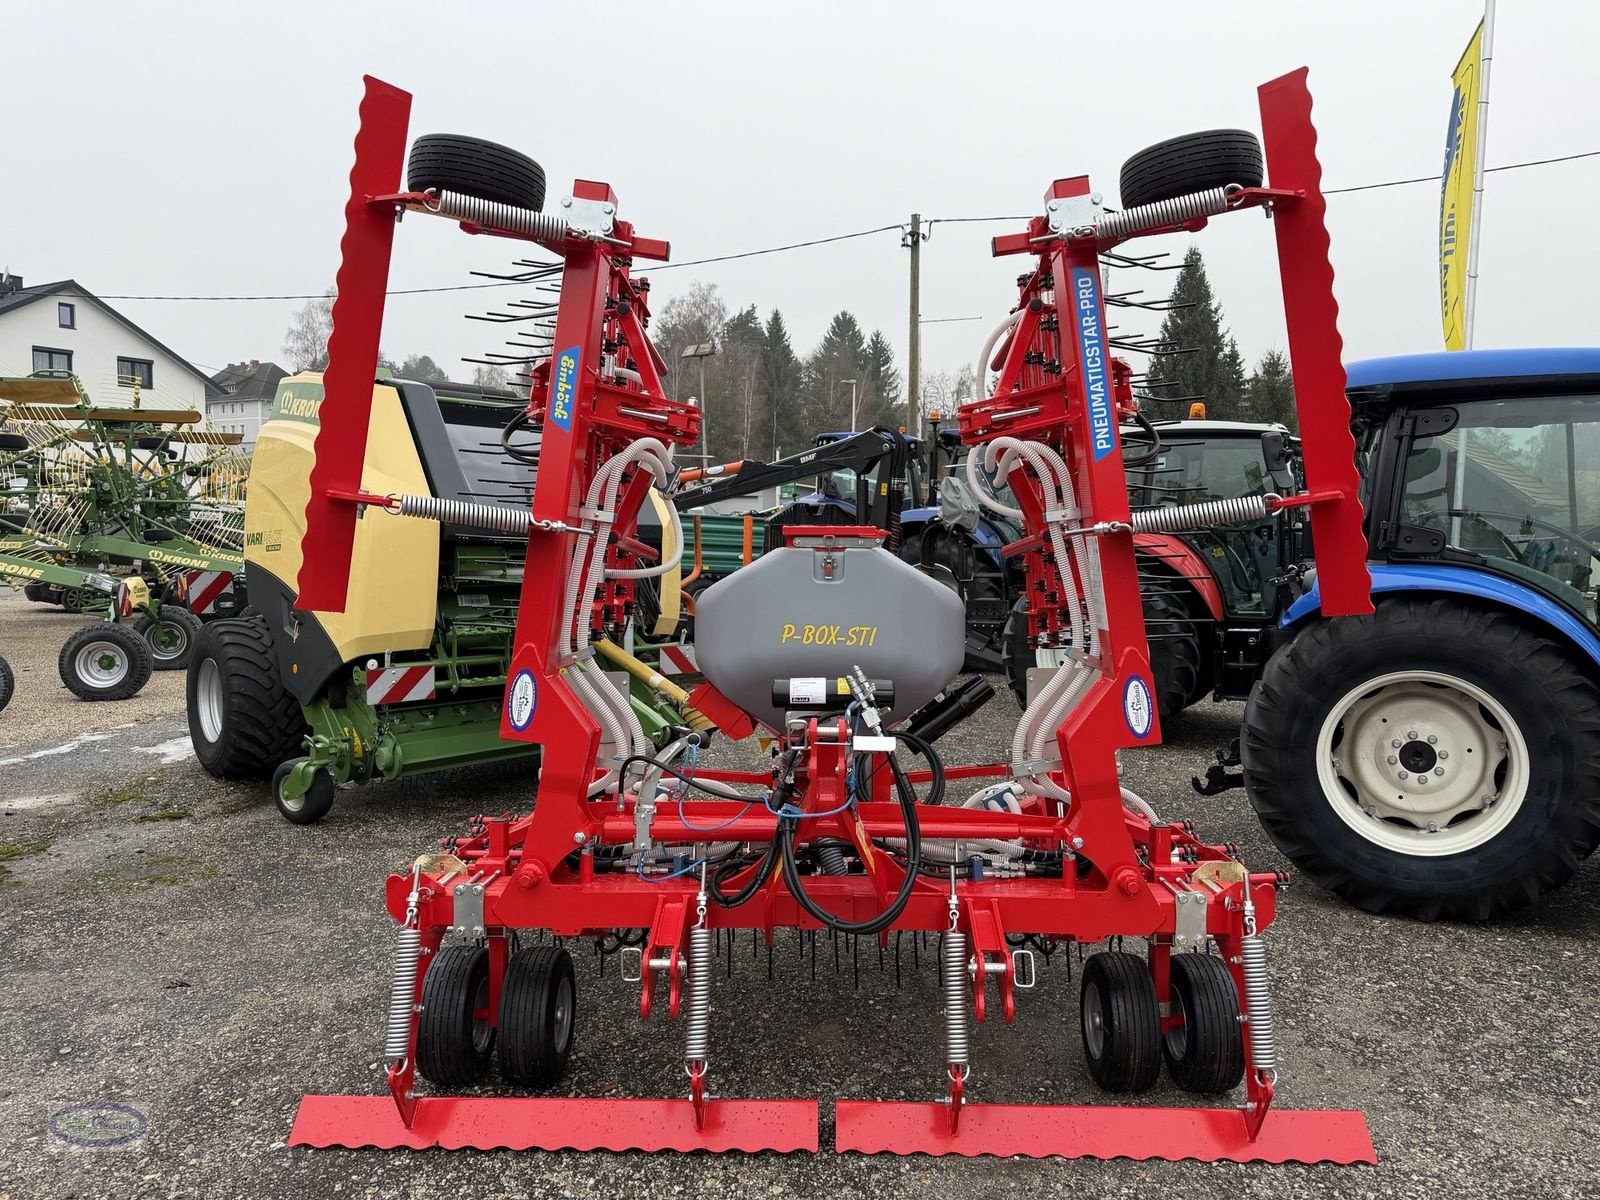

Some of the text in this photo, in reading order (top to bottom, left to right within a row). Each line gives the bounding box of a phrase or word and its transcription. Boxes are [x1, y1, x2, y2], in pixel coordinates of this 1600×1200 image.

[1077, 276, 1112, 450] PNEUMATICSTAR-PRO
[554, 355, 575, 420] Einböck
[290, 398, 321, 418] KRON
[163, 554, 211, 569] KRONE
[211, 552, 244, 564] KRON
[0, 561, 45, 579] RONE
[781, 623, 878, 647] P-BOX-STI
